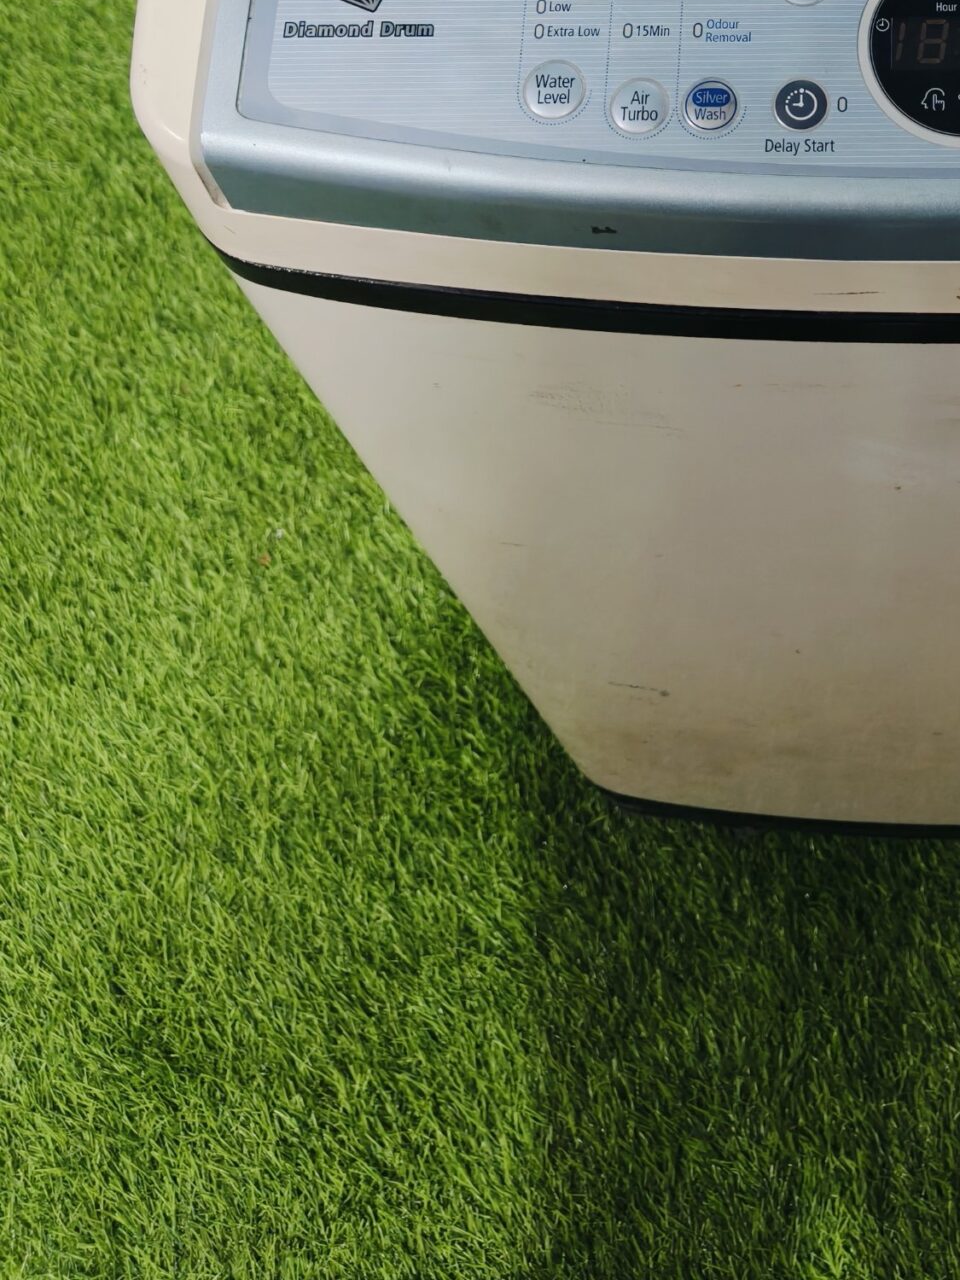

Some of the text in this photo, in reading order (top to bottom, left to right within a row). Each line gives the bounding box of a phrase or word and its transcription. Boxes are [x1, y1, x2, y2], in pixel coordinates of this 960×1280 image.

[549, 1, 572, 13] Low
[936, 2, 958, 12] Hour
[283, 20, 435, 38] Diamond Drum
[547, 25, 601, 38] Extra Low
[636, 25, 670, 38] 15Min
[706, 19, 740, 30] Odour
[705, 31, 752, 43] Removal
[535, 74, 575, 90] Water
[537, 89, 571, 105] Level
[631, 91, 650, 105] Air
[695, 91, 727, 105] Silver
[621, 107, 659, 122] Turbo
[694, 107, 727, 121] Wash
[764, 138, 835, 156] Delay Start
